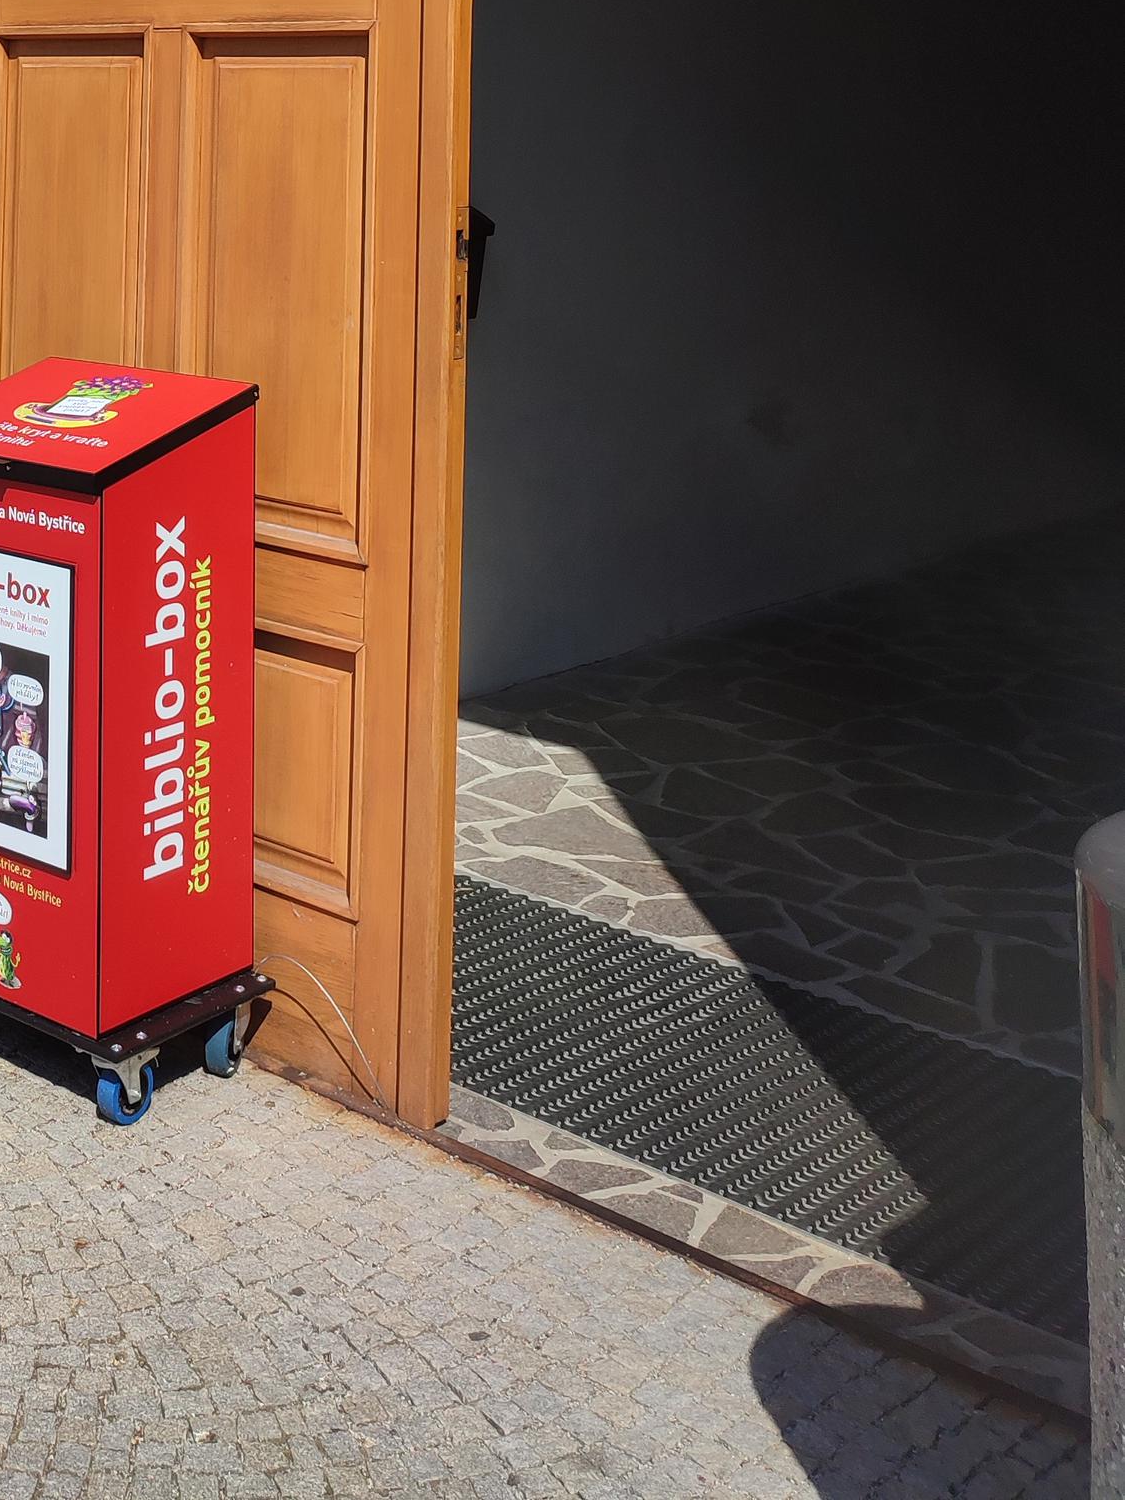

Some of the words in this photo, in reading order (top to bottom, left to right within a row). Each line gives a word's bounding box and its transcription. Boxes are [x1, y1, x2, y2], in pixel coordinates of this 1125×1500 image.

[18, 426, 49, 440] kryt
[8, 506, 36, 525] Nová
[38, 512, 86, 534] Bystřice
[189, 555, 215, 728] pomocník
[143, 516, 186, 881] biblio-box
[186, 739, 211, 894] čtenářův
[3, 874, 24, 894] Nová
[27, 884, 62, 908] Bystřice
